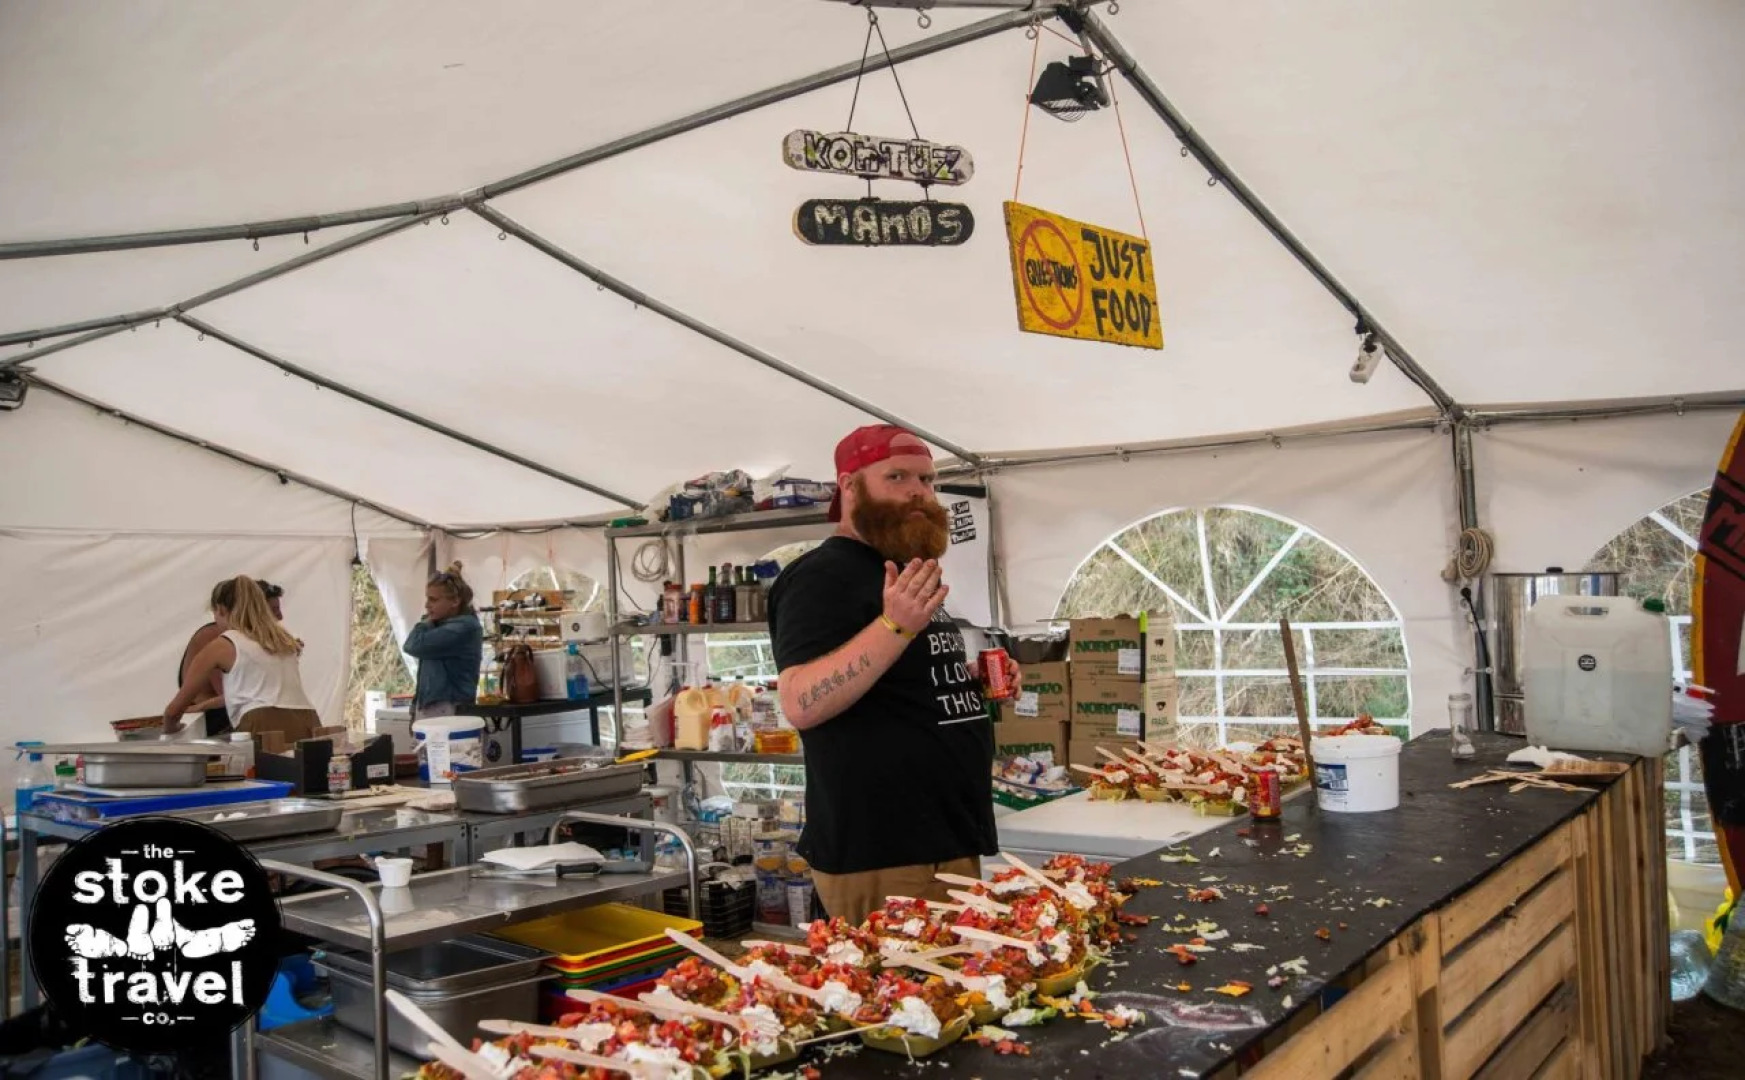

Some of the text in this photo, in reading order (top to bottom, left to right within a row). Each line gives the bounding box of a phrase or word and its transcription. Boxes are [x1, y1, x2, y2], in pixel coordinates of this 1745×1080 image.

[1081, 228, 1148, 283] JUST
[1091, 288, 1152, 338] FOOD
[930, 666, 939, 687] I
[936, 691, 982, 716] THIS
